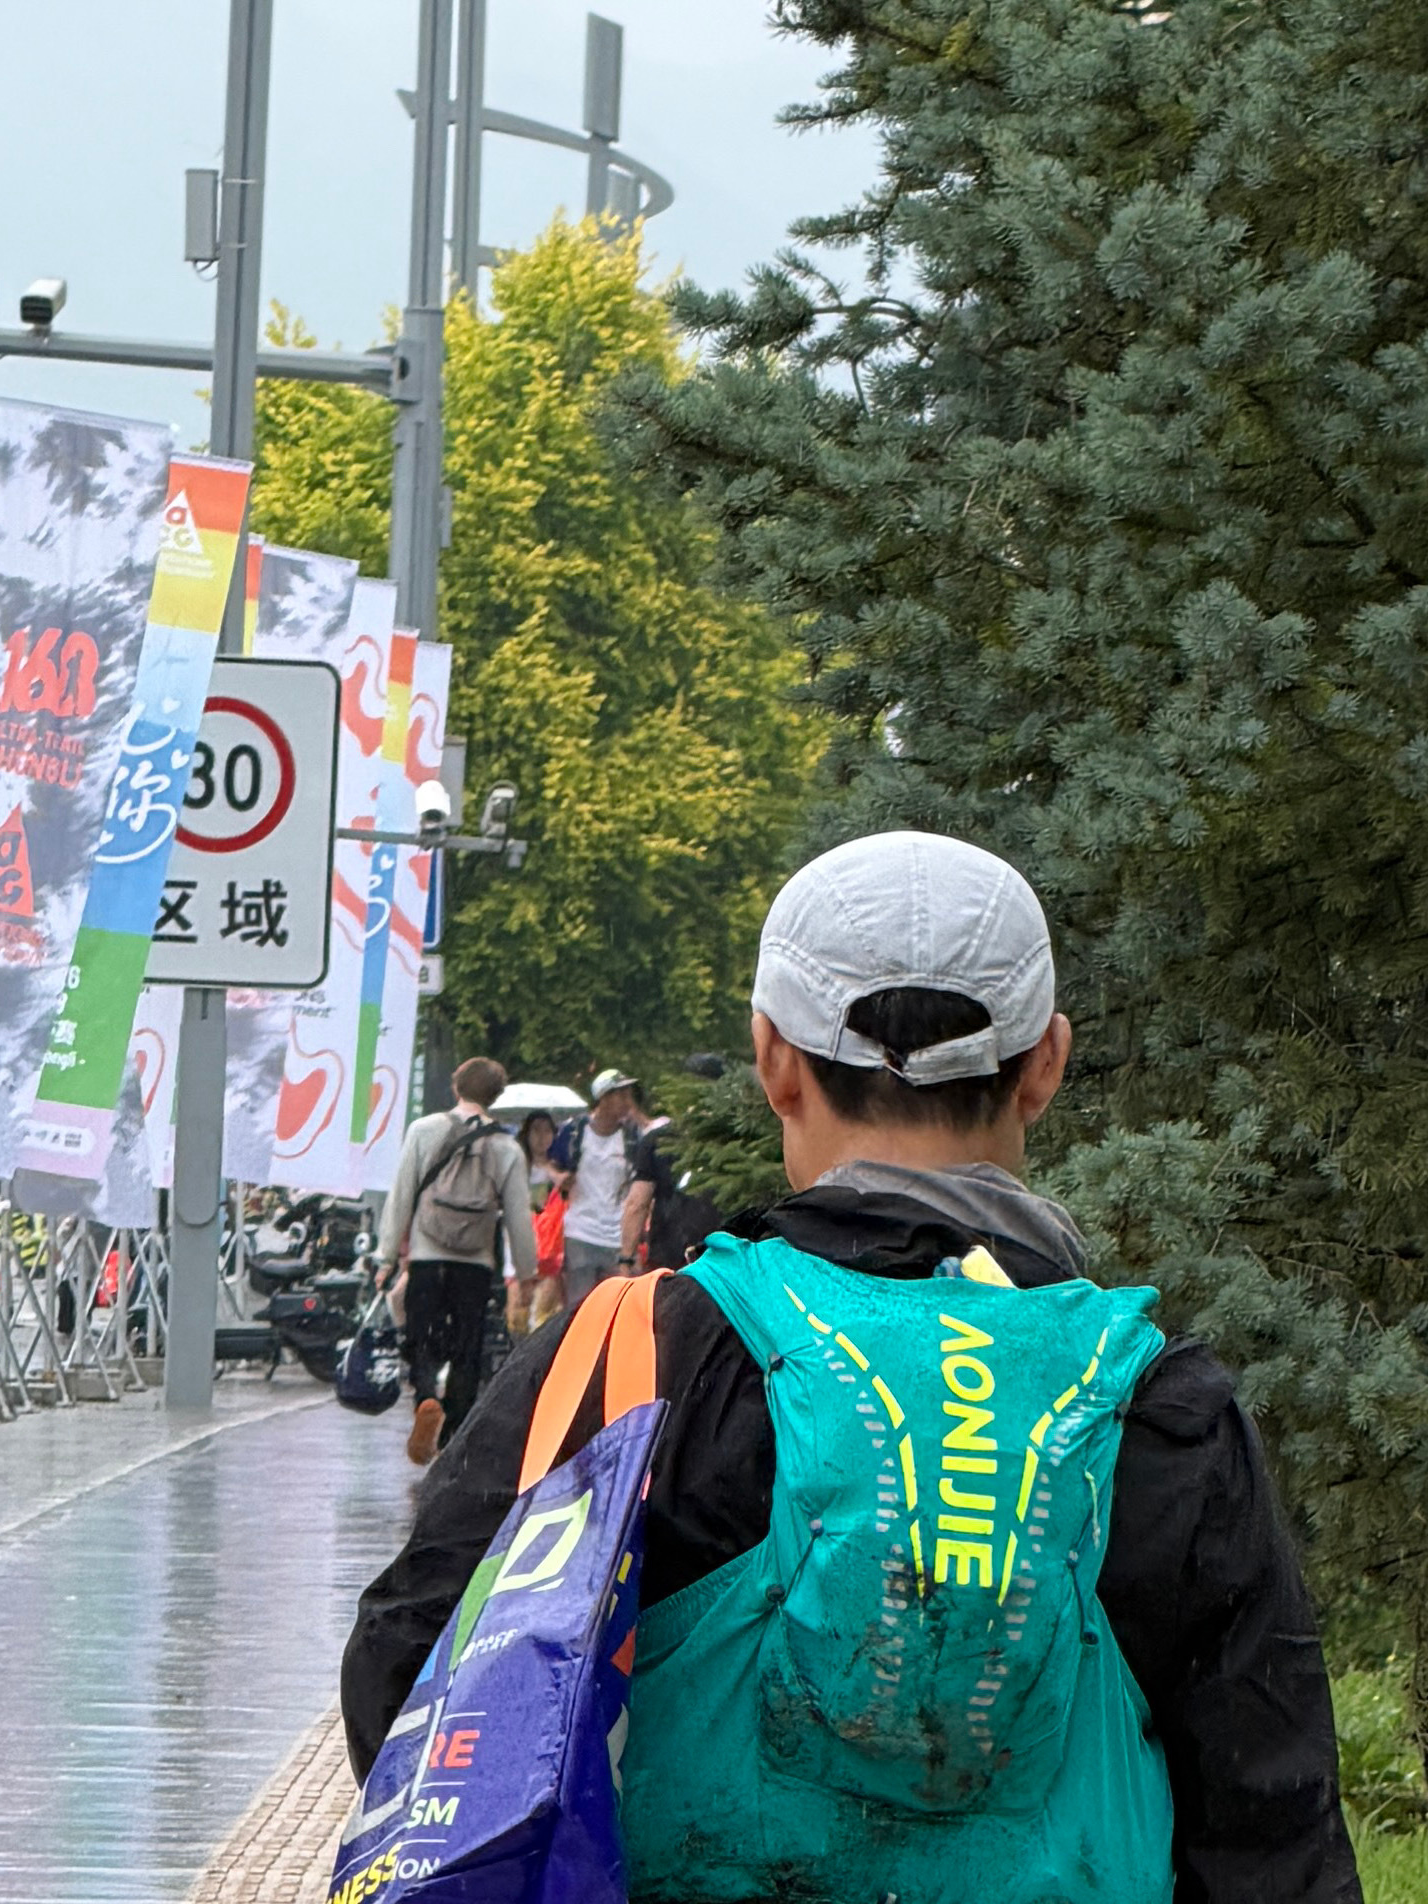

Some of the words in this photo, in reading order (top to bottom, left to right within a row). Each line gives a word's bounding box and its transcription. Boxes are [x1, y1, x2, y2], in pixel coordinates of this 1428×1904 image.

[183, 740, 263, 812] 30
[151, 880, 289, 946] 区域
[934, 1312, 998, 1588] AONIJIE
